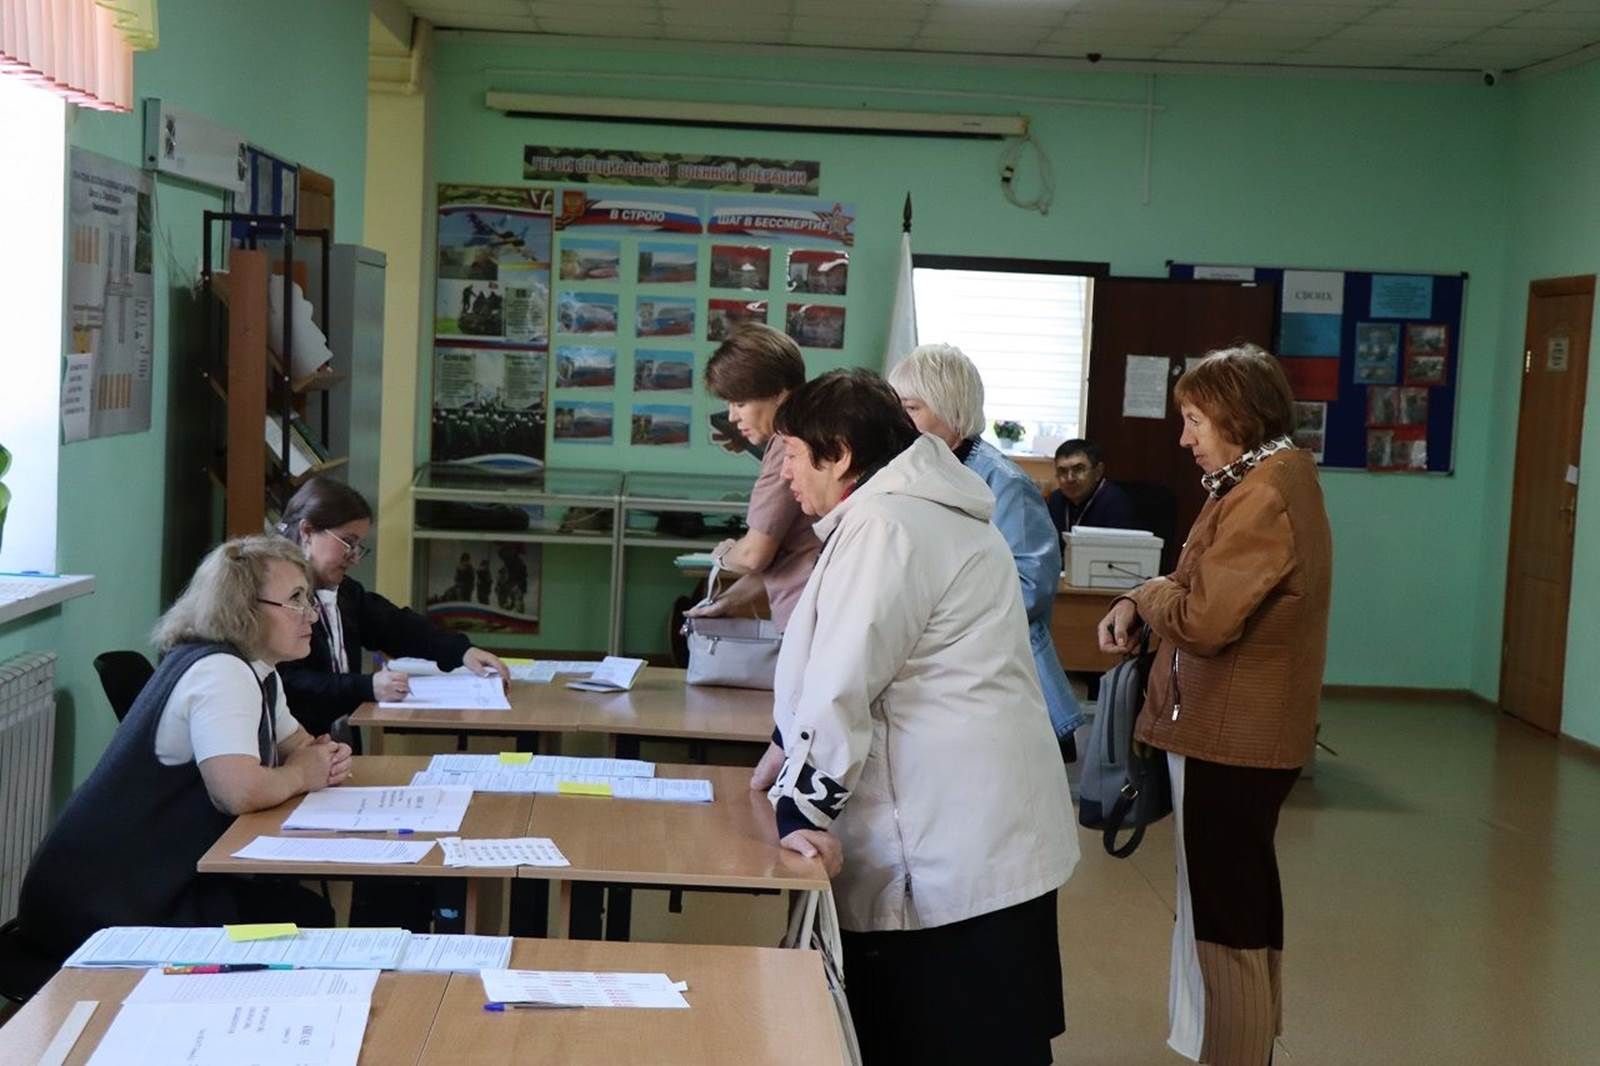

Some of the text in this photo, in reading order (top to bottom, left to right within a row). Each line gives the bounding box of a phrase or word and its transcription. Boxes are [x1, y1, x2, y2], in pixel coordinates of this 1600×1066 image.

[610, 208, 666, 222] В СТРОЮ
[718, 213, 743, 226] ШАГ
[744, 216, 752, 227] В
